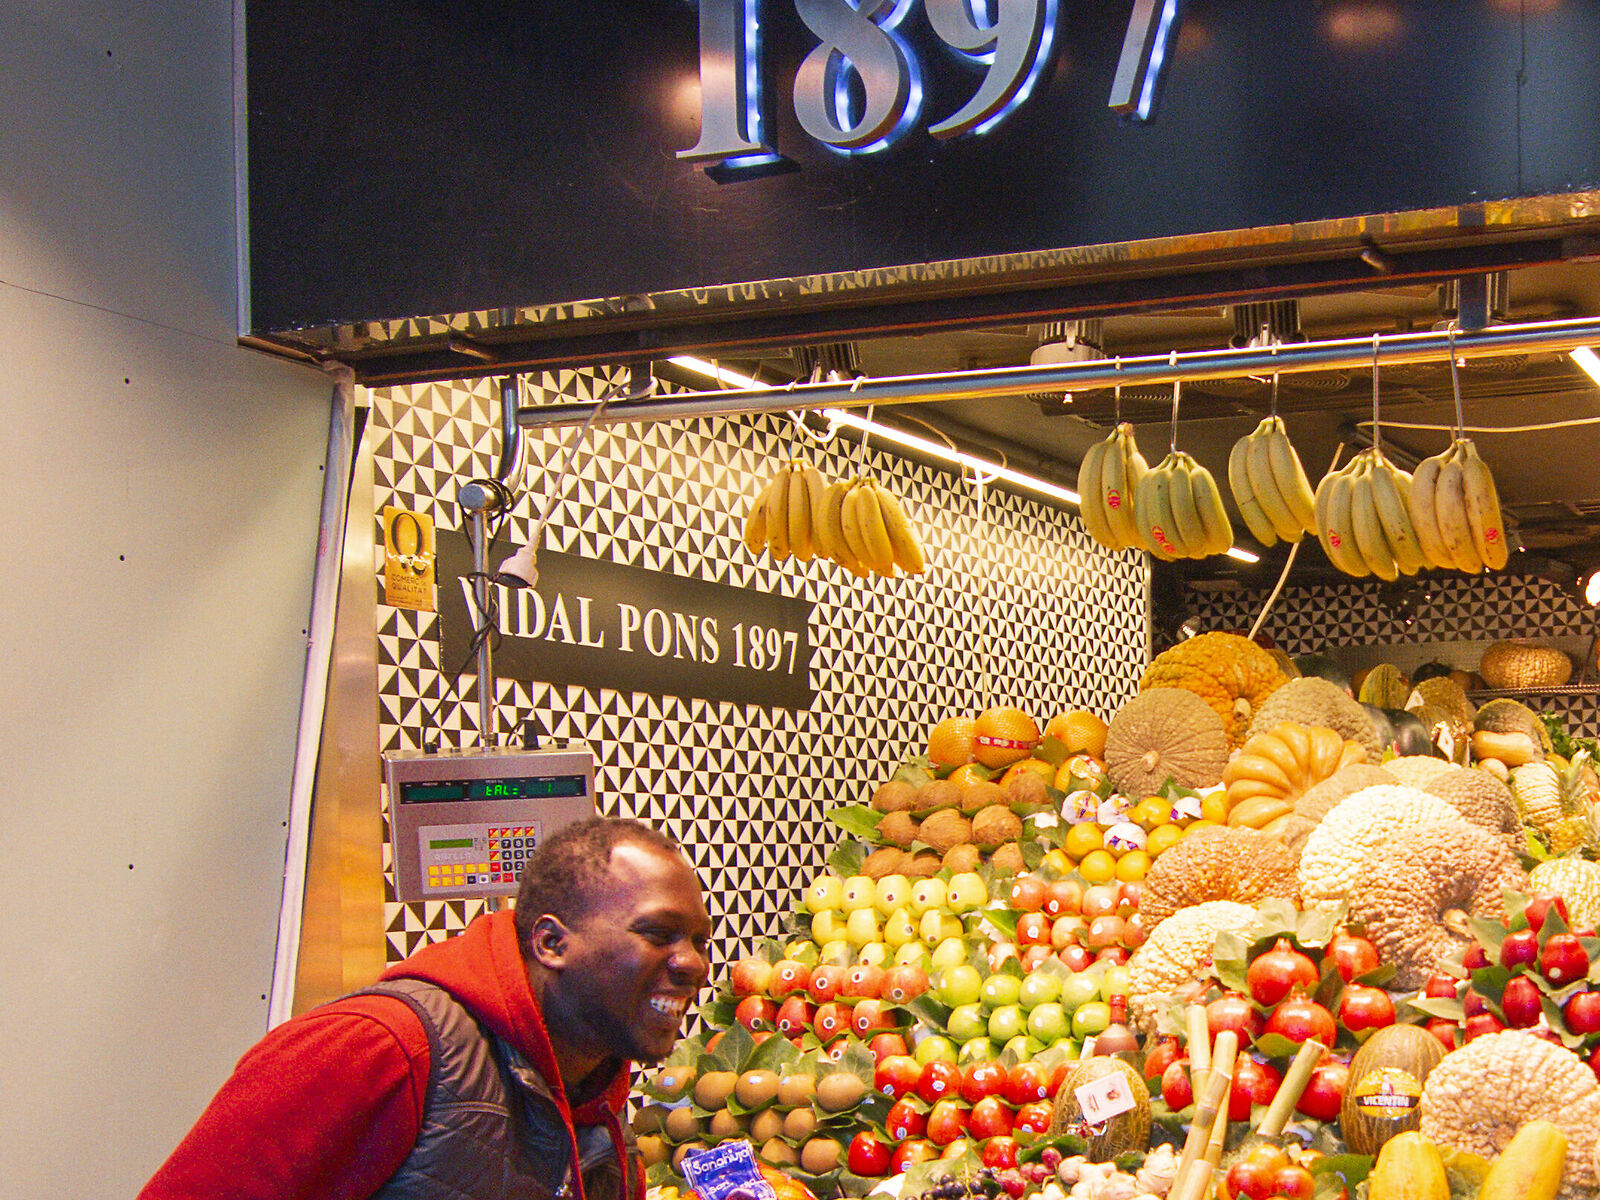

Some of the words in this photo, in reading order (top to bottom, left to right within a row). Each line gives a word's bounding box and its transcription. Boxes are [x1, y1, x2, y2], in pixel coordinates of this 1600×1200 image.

[617, 603, 720, 665] PONS
[732, 622, 798, 675] 1897
[692, 1149, 750, 1175] Sanahuja
